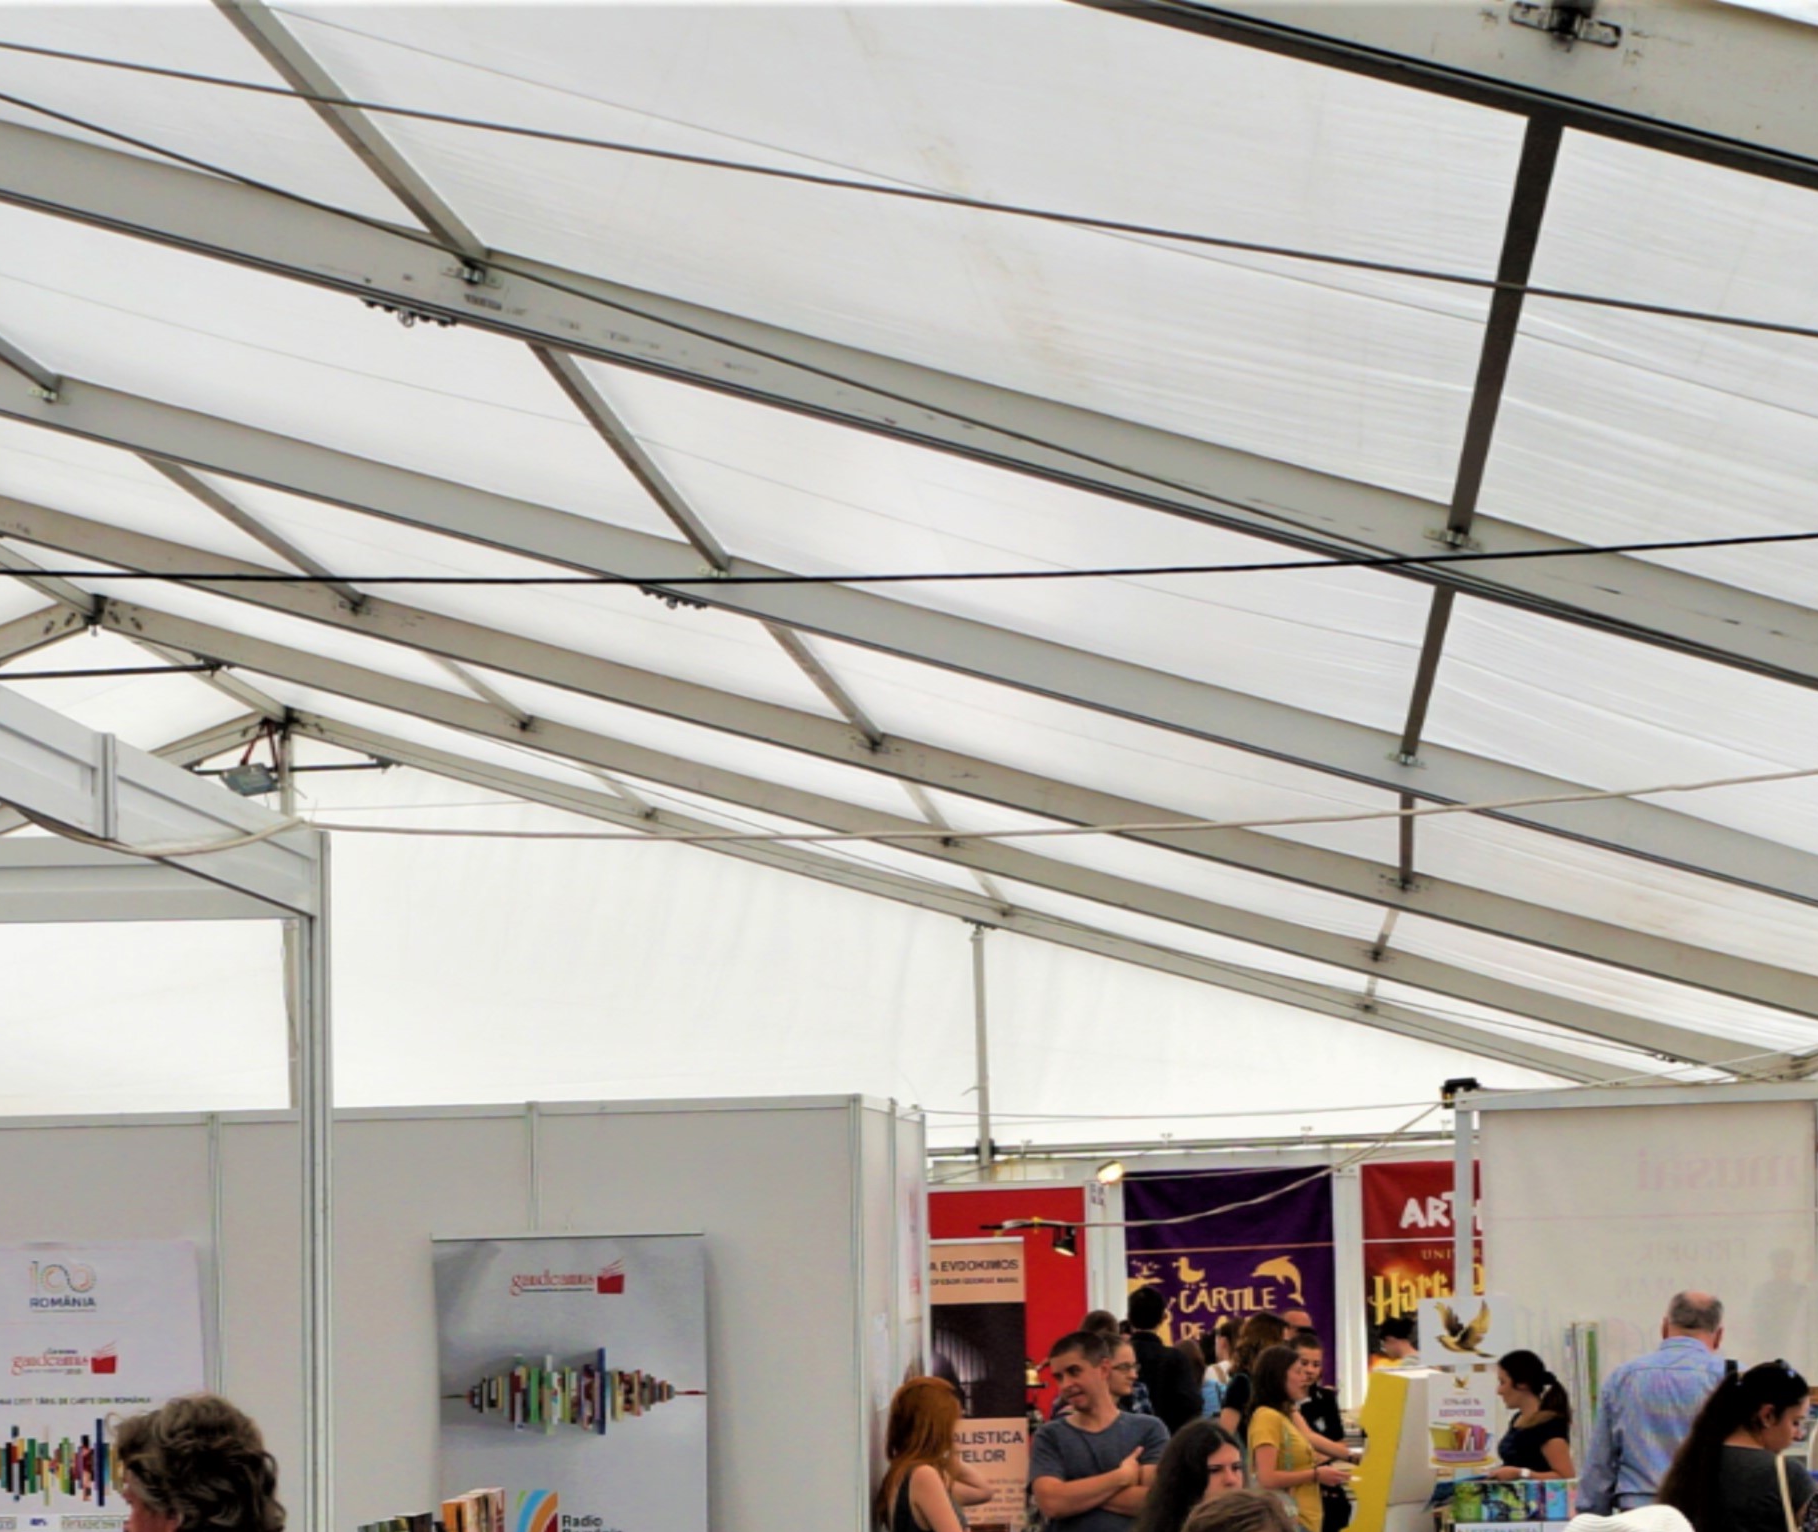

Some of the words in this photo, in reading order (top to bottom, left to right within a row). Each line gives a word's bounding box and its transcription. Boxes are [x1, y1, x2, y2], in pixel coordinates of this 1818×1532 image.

[1399, 1190, 1482, 1231] ART
[29, 1295, 96, 1308] ROMÂNIA
[562, 1514, 603, 1528] Radio
